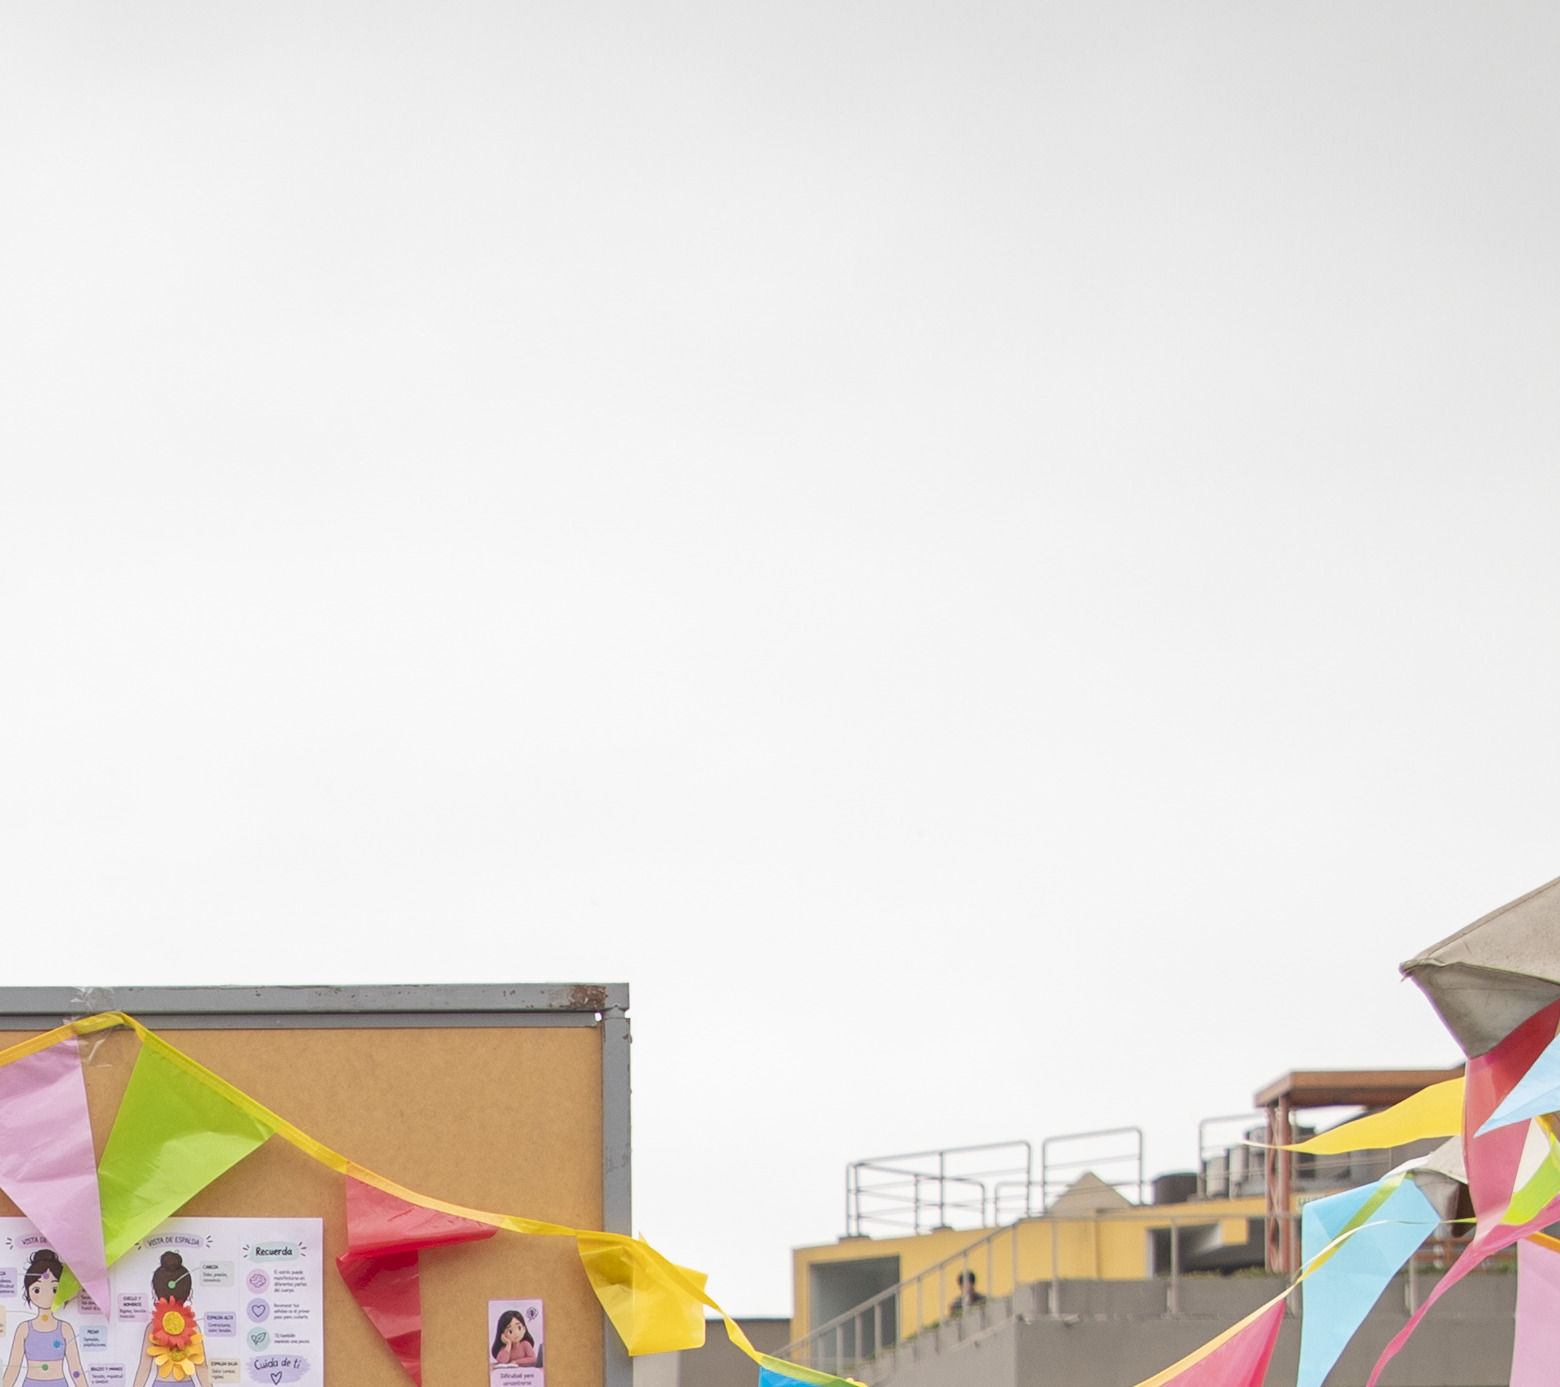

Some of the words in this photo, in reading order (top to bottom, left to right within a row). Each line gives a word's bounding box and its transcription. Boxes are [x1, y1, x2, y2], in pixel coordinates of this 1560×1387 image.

[147, 1237, 164, 1246] VISTA
[165, 1236, 174, 1244] DE
[175, 1236, 200, 1246] ESPALDA
[255, 1246, 293, 1256] Recuerda
[254, 1358, 278, 1370] Cuida
[280, 1356, 292, 1368] de
[293, 1358, 302, 1370] ti
